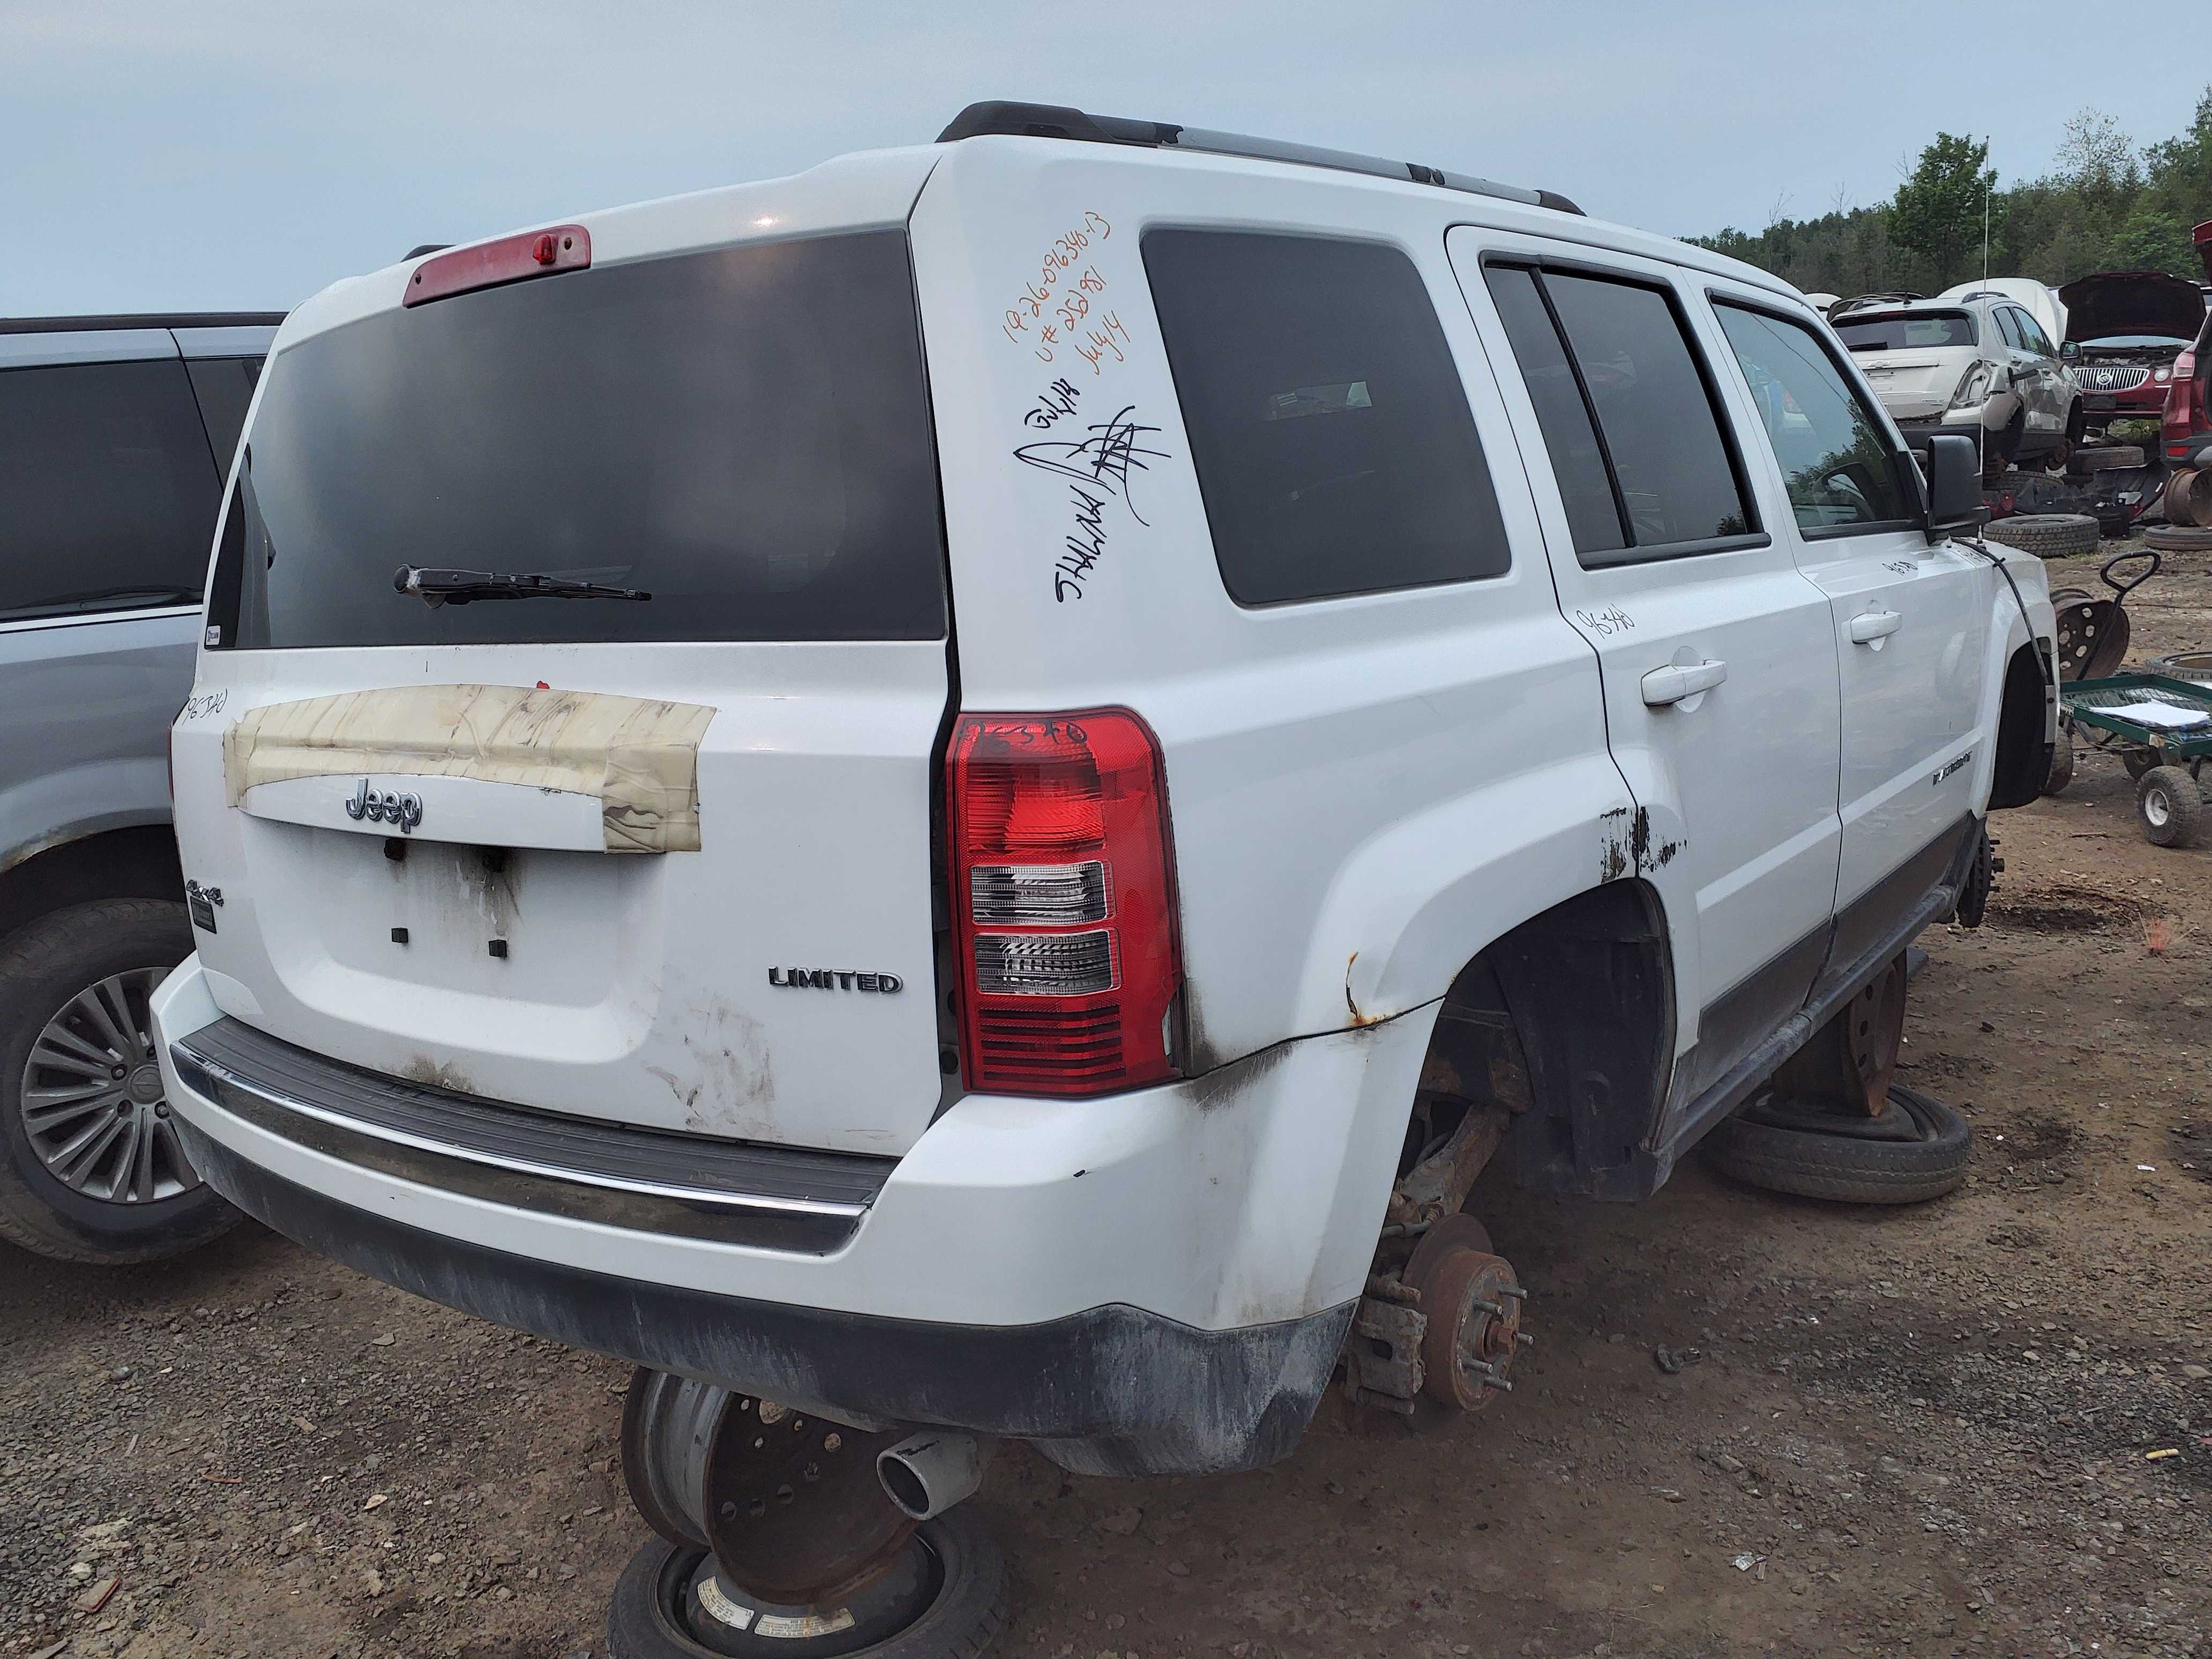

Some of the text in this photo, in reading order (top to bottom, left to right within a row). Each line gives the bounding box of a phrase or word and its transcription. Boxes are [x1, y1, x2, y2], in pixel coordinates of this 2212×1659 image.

[1576, 603, 1634, 639] 96340
[346, 778, 422, 833] Jeep
[768, 965, 903, 993] LIMITED
